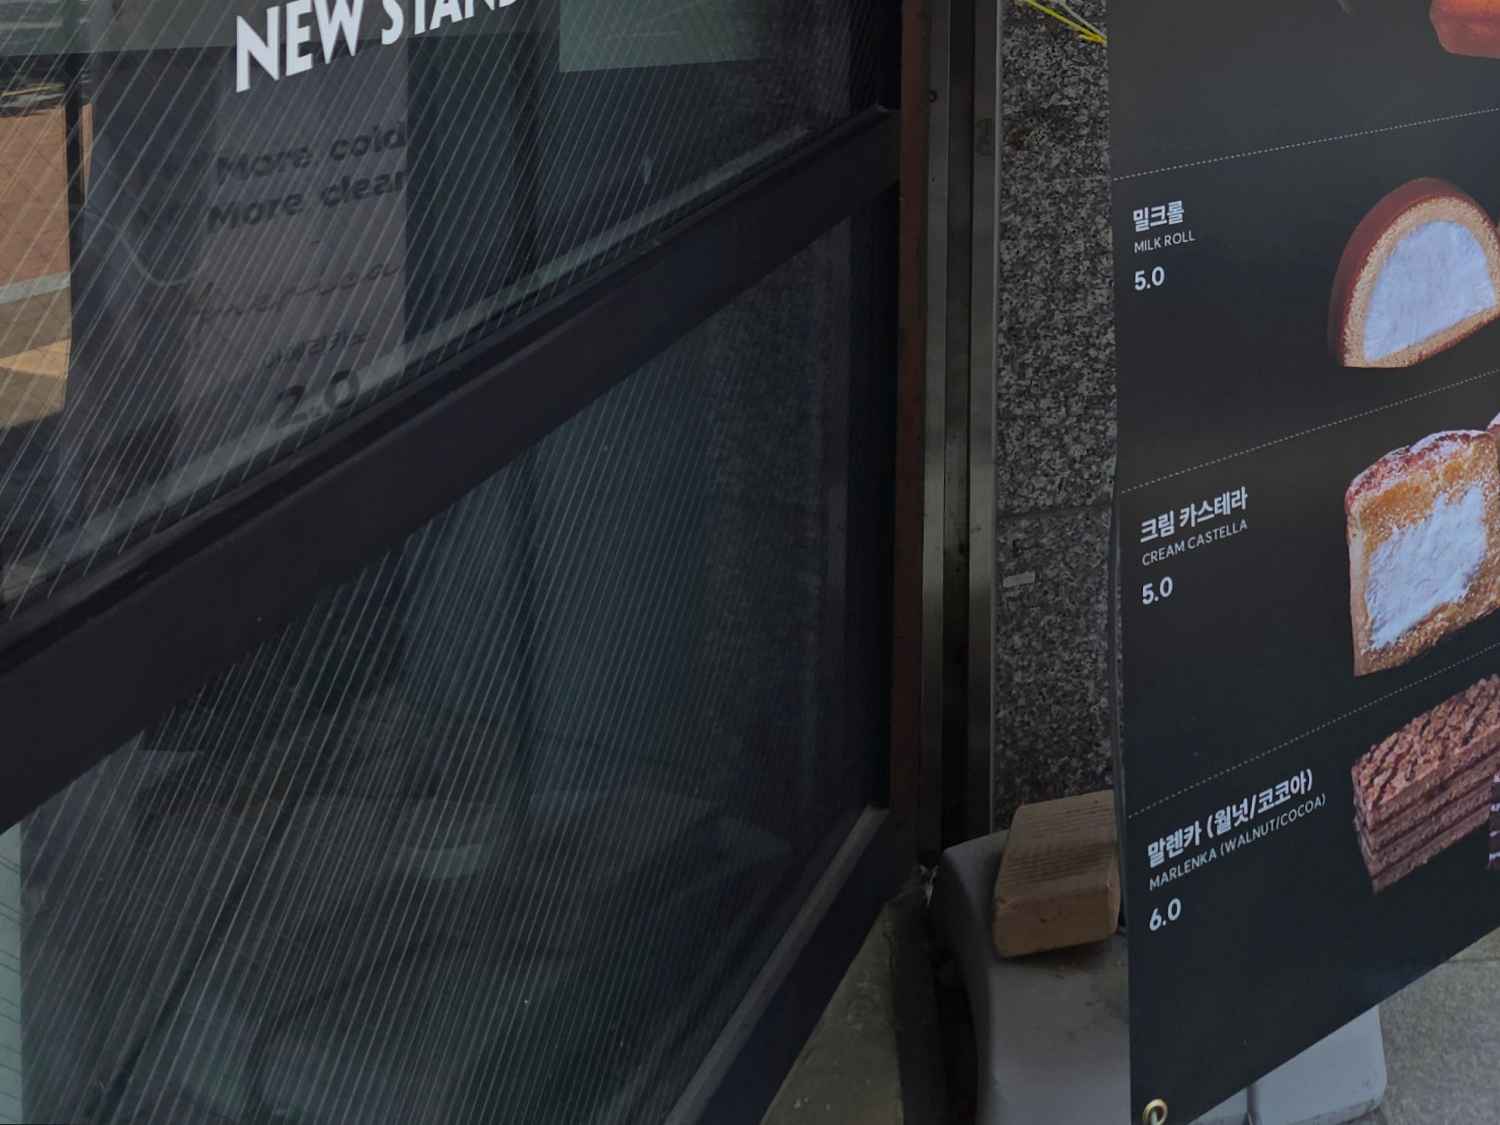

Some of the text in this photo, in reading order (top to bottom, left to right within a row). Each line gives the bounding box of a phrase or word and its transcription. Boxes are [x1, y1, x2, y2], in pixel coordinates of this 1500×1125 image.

[1133, 200, 1185, 231] 밀크롤
[1134, 230, 1195, 254] MILK ROLL
[1134, 267, 1165, 292] 5.0
[1140, 485, 1249, 544] 크림 카스테라
[1141, 519, 1248, 566] CREAM CASTELLA
[1141, 576, 1173, 606] 5.0
[1147, 769, 1313, 869] 말렌카 (월넛/코코아)
[1149, 793, 1326, 891] MARLENKA (WALNUT/COCOA)
[1149, 898, 1181, 931] 6.0
